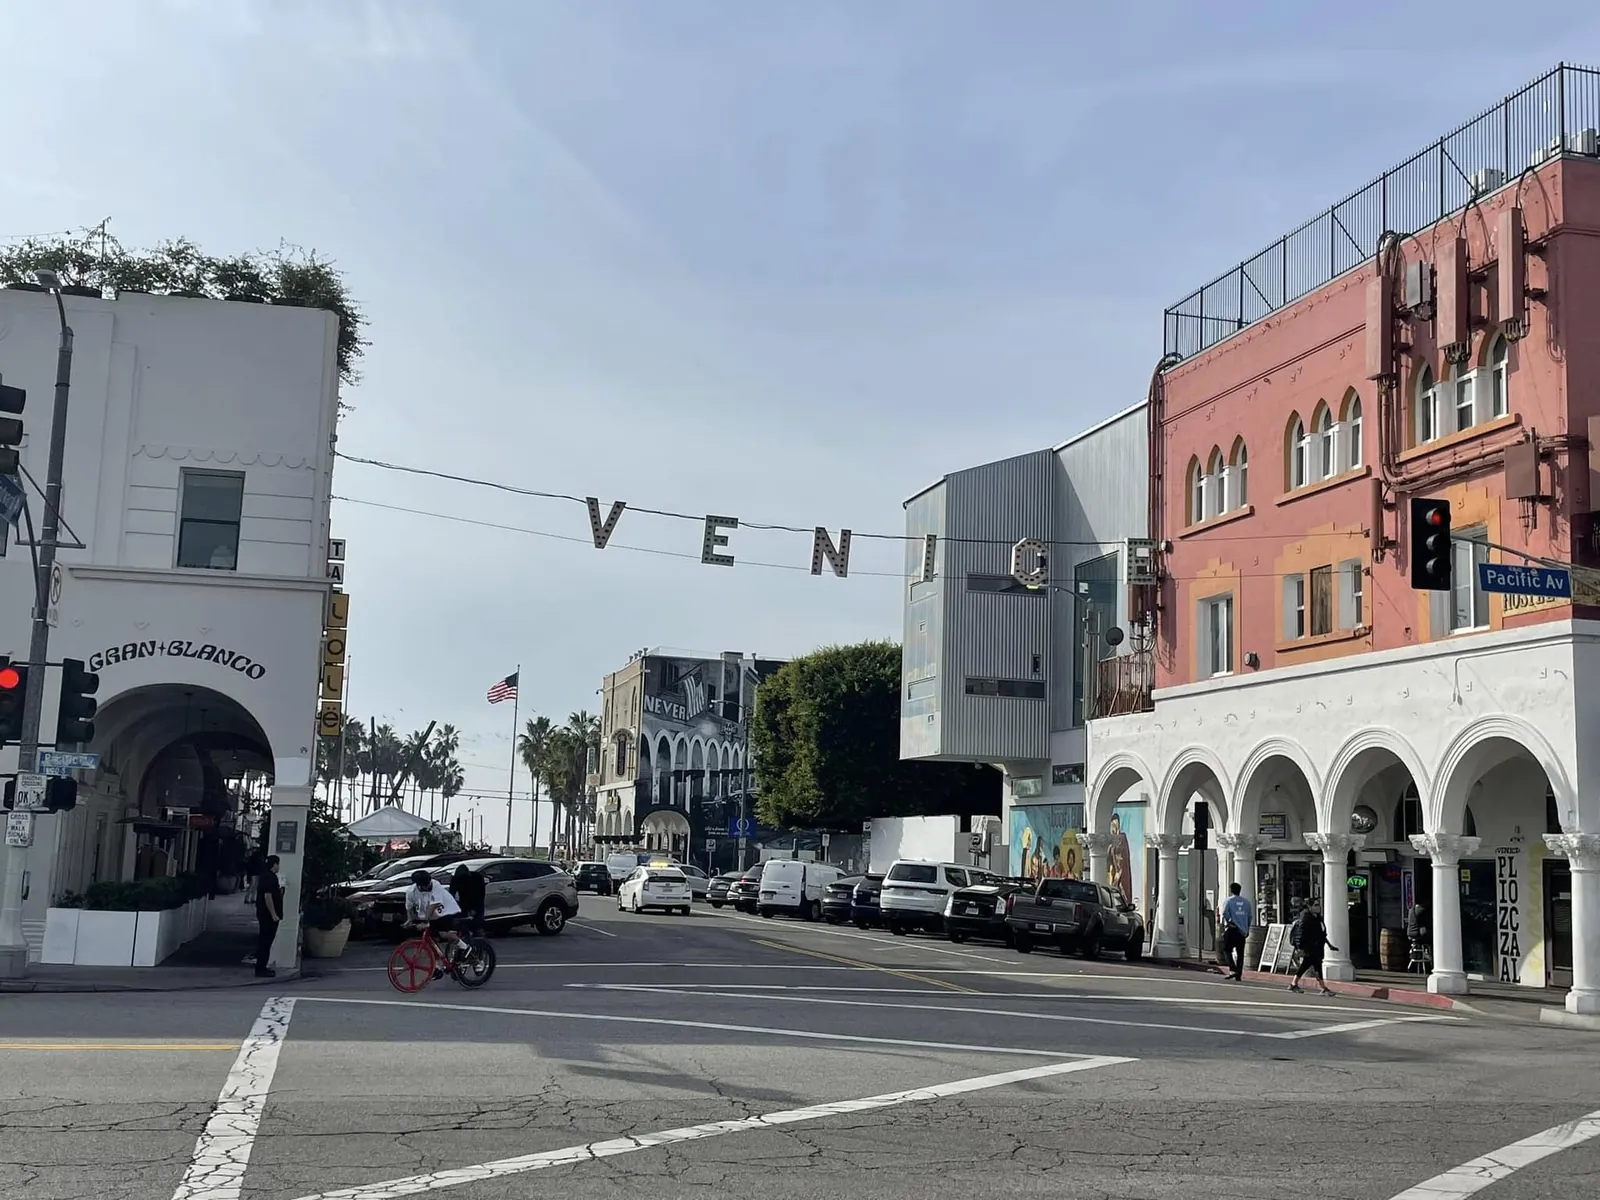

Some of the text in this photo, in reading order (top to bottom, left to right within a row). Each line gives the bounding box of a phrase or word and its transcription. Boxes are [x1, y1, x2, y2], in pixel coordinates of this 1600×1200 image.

[586, 497, 1157, 586] VENICE
[1486, 569, 1541, 588] Pacific
[1546, 574, 1564, 590] Av
[89, 640, 266, 680] GRAN BLANCO
[643, 694, 686, 720] NEVER
[17, 790, 29, 804] OK
[1347, 877, 1367, 886] ATM
[1498, 856, 1510, 982] PIZZA
[1508, 856, 1521, 984] LOCAL
